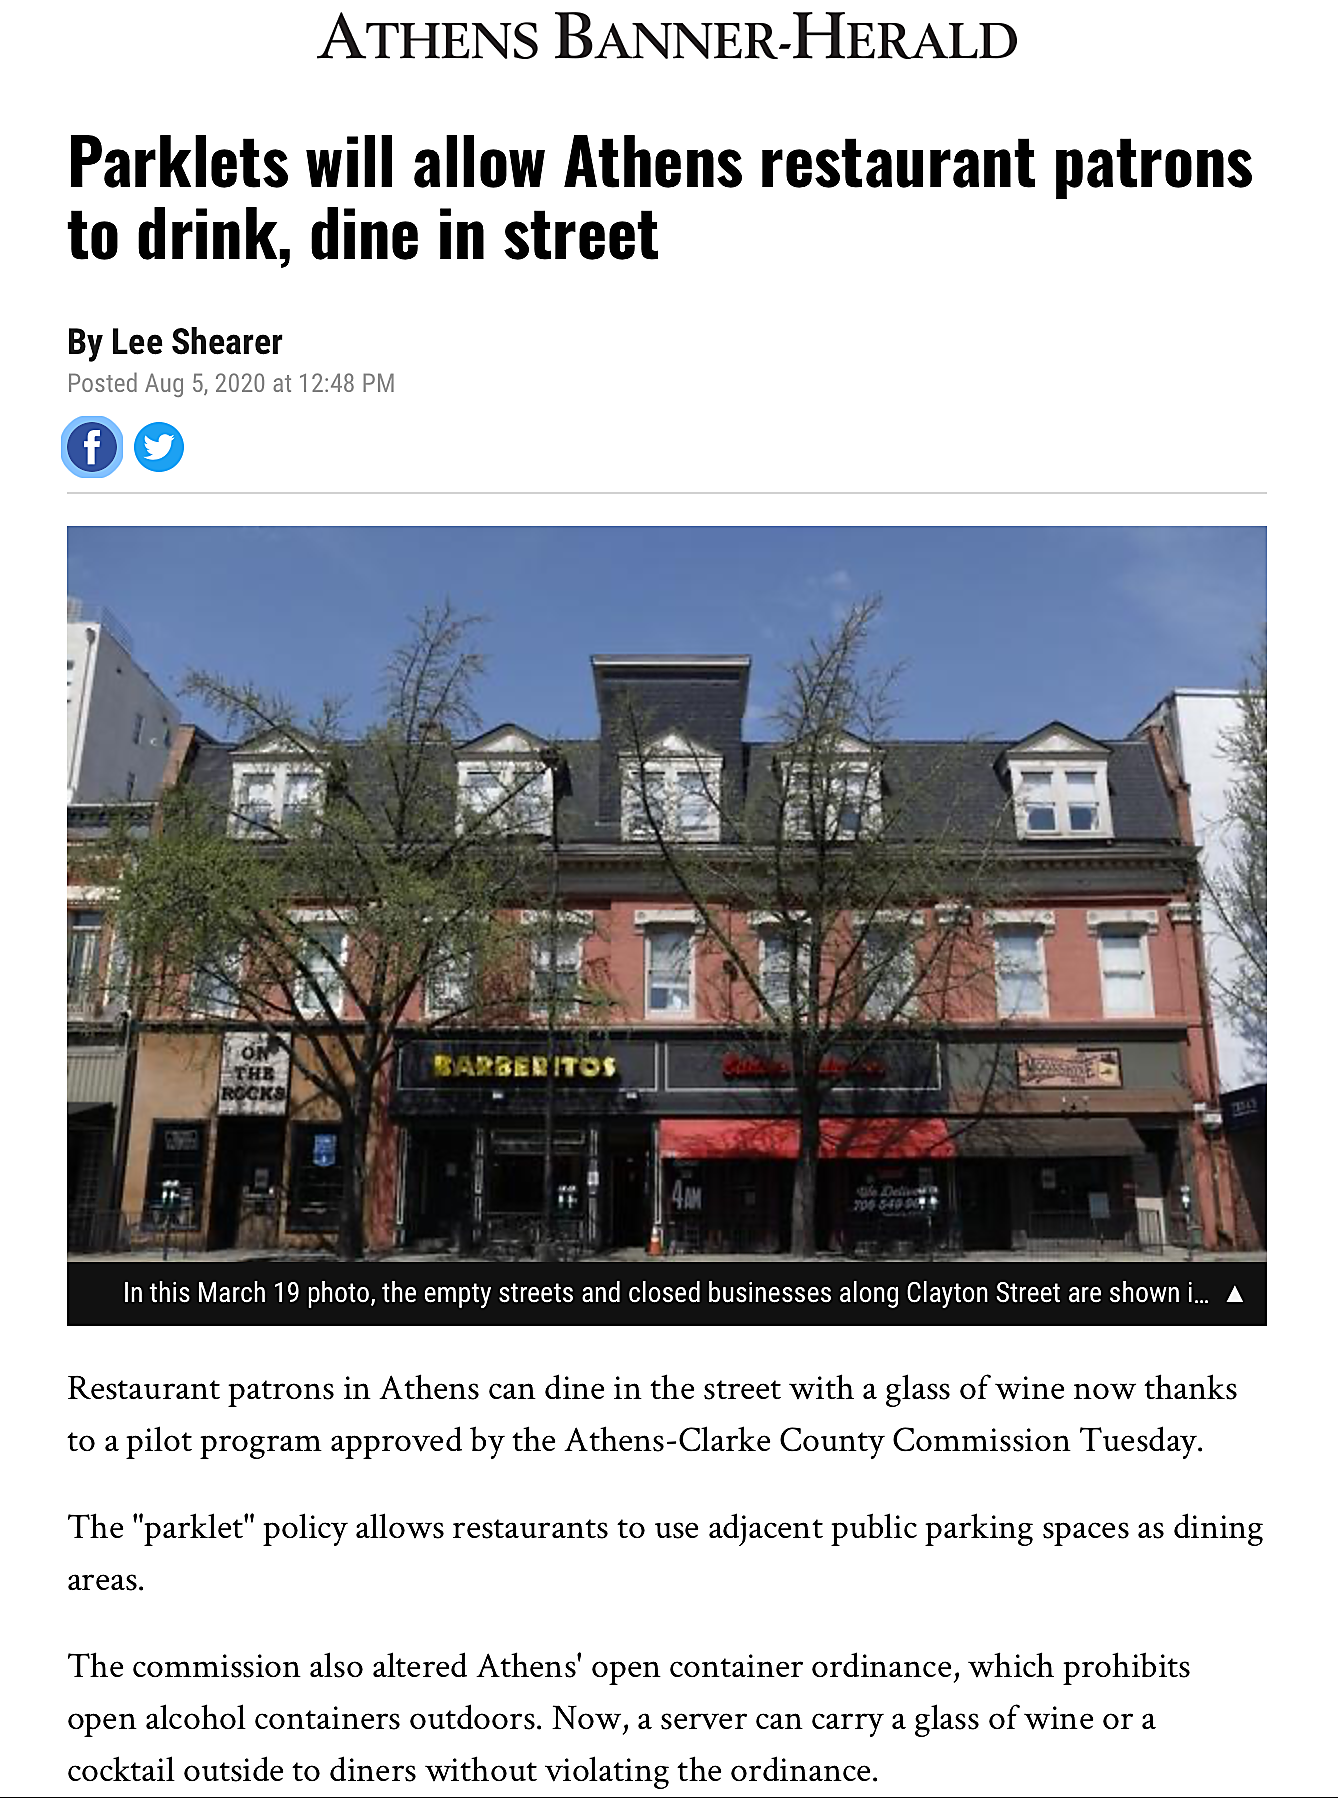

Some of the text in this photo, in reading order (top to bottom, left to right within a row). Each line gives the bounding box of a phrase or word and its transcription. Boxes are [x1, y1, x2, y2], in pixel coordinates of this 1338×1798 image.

[241, 1046, 271, 1061] ON
[234, 1066, 275, 1081] THE
[433, 1055, 617, 1077] BARBERITOS
[221, 1086, 285, 1101] ROCKS
[672, 1179, 683, 1211] 4
